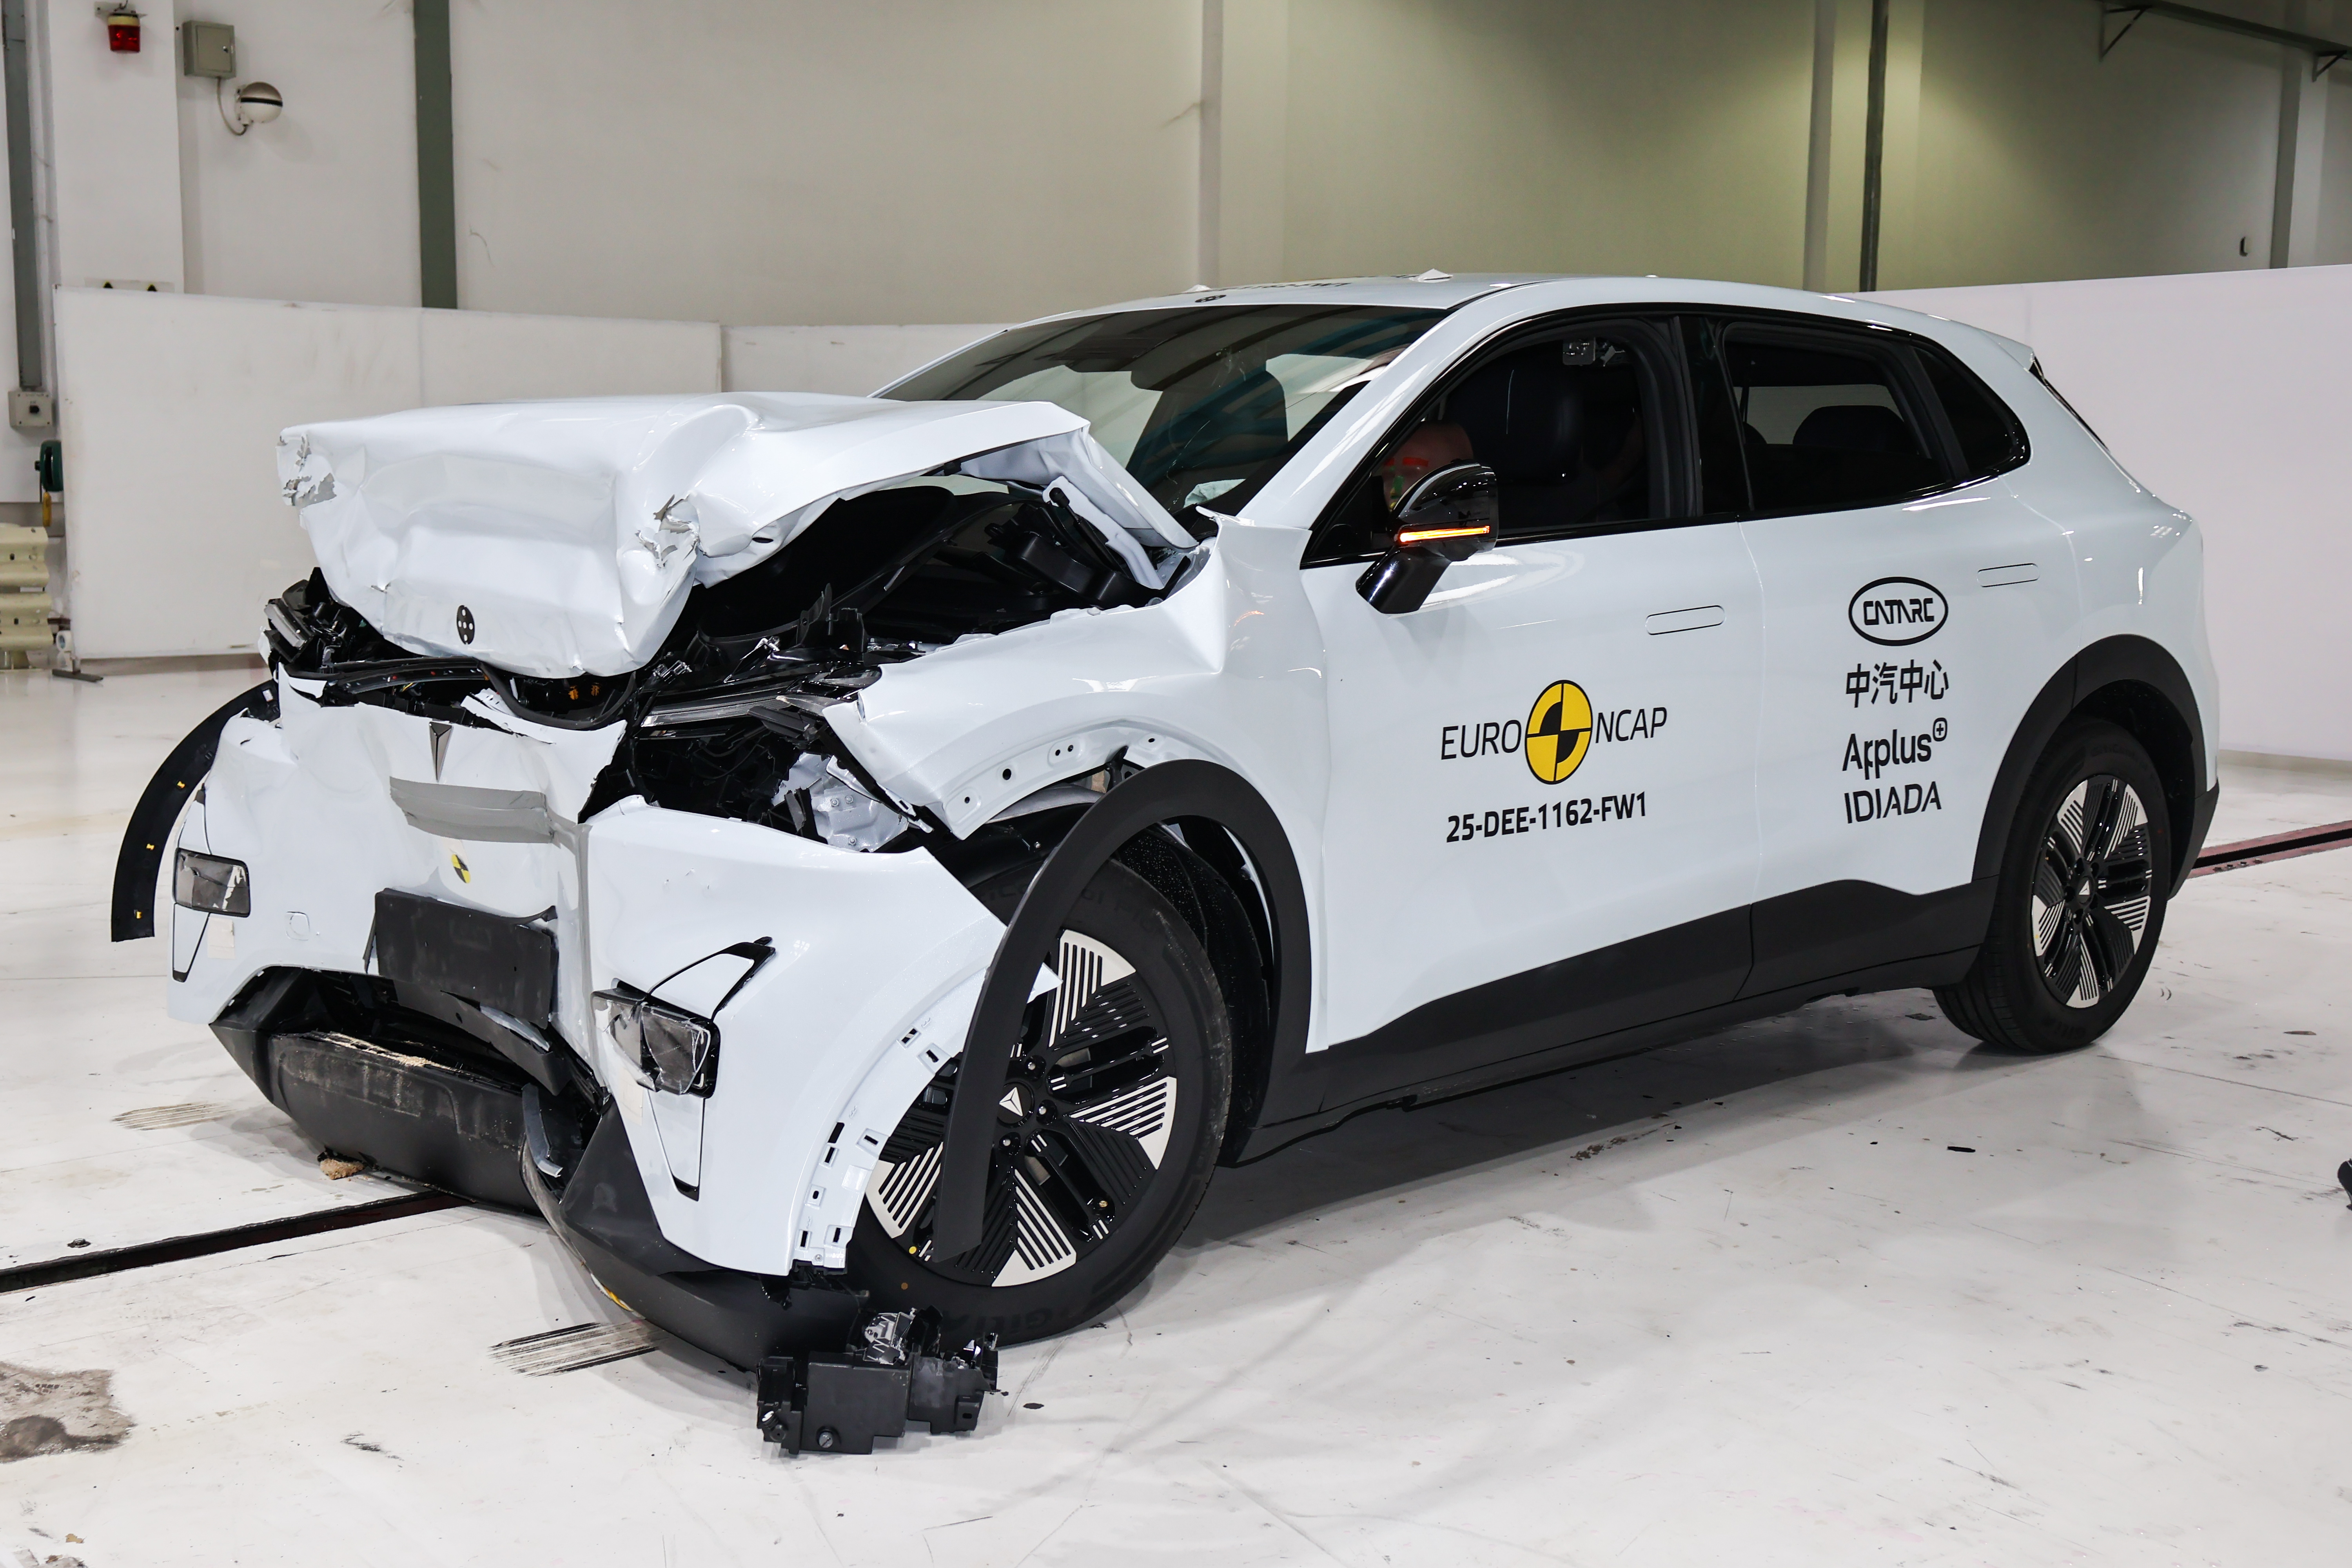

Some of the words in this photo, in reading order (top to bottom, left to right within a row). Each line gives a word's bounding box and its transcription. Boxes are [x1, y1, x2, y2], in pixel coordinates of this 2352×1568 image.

[1863, 597, 1935, 626] CATARC
[1845, 659, 1949, 708] 中汽中心
[1441, 719, 1522, 760] EURO
[1595, 706, 1668, 744] NCAP
[1446, 791, 1646, 843] 25-DEE-1162-FW1
[1844, 780, 1942, 824] IDIADA
